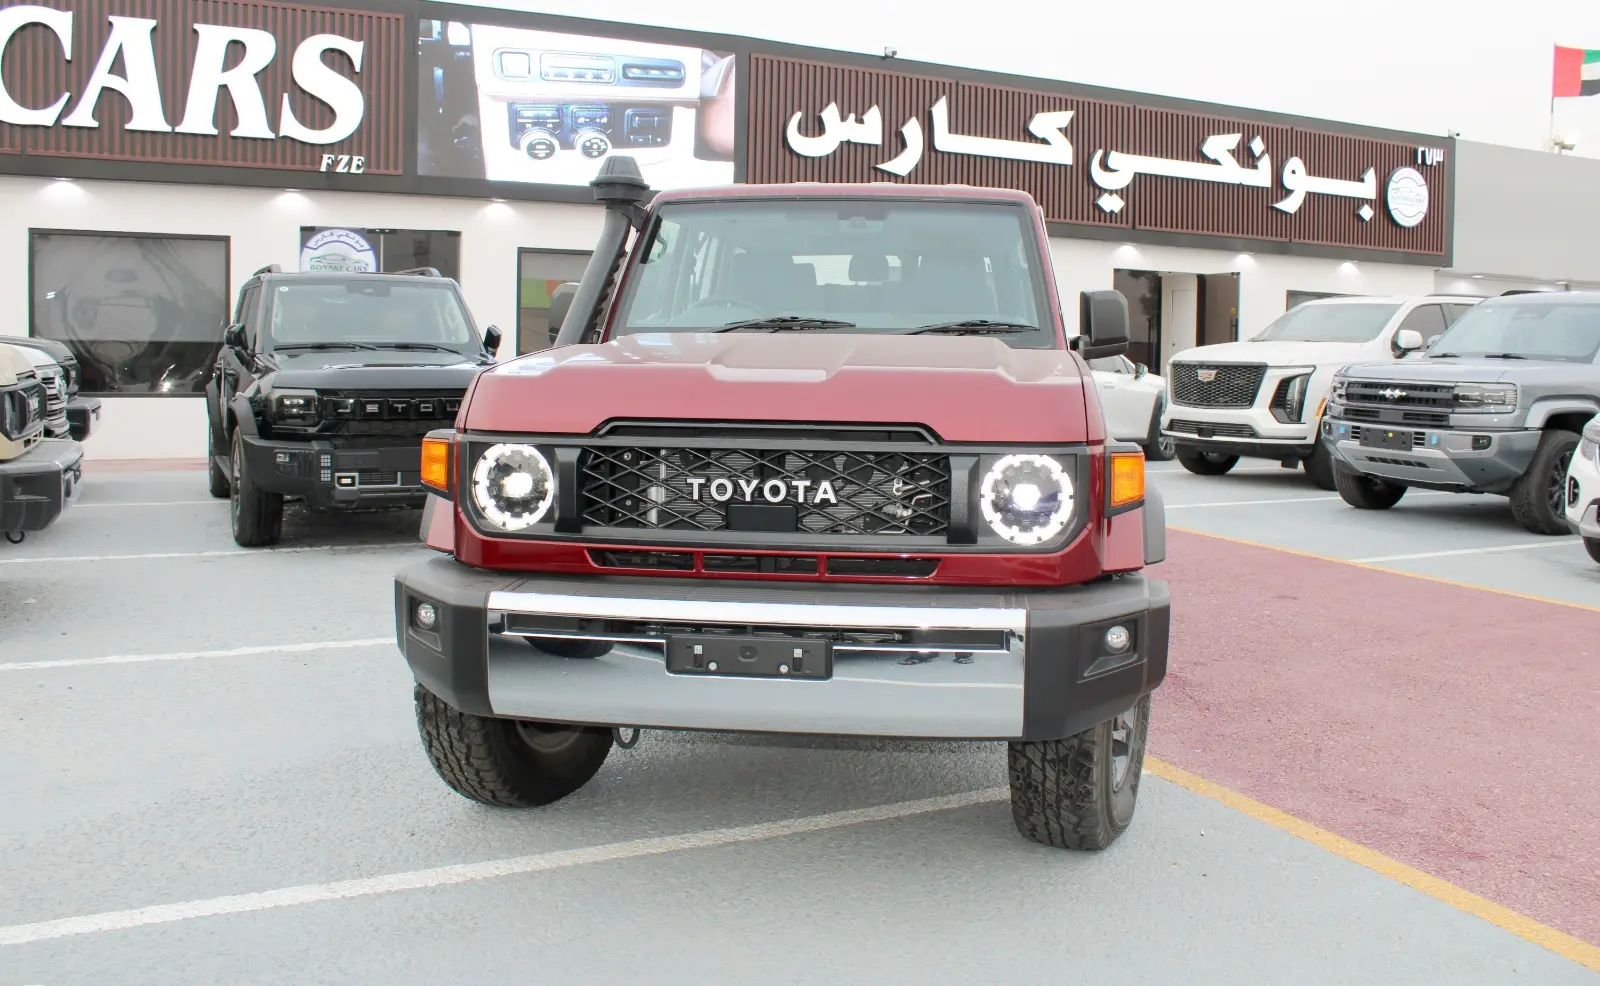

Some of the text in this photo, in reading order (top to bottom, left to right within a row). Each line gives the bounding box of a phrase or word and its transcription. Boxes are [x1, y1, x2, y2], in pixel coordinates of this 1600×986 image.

[0, 4, 365, 145] CARS
[319, 153, 366, 174] FZE
[786, 95, 1378, 222] بونكي كارس
[337, 403, 459, 413] JETOU
[686, 477, 838, 504] TOYOTA
